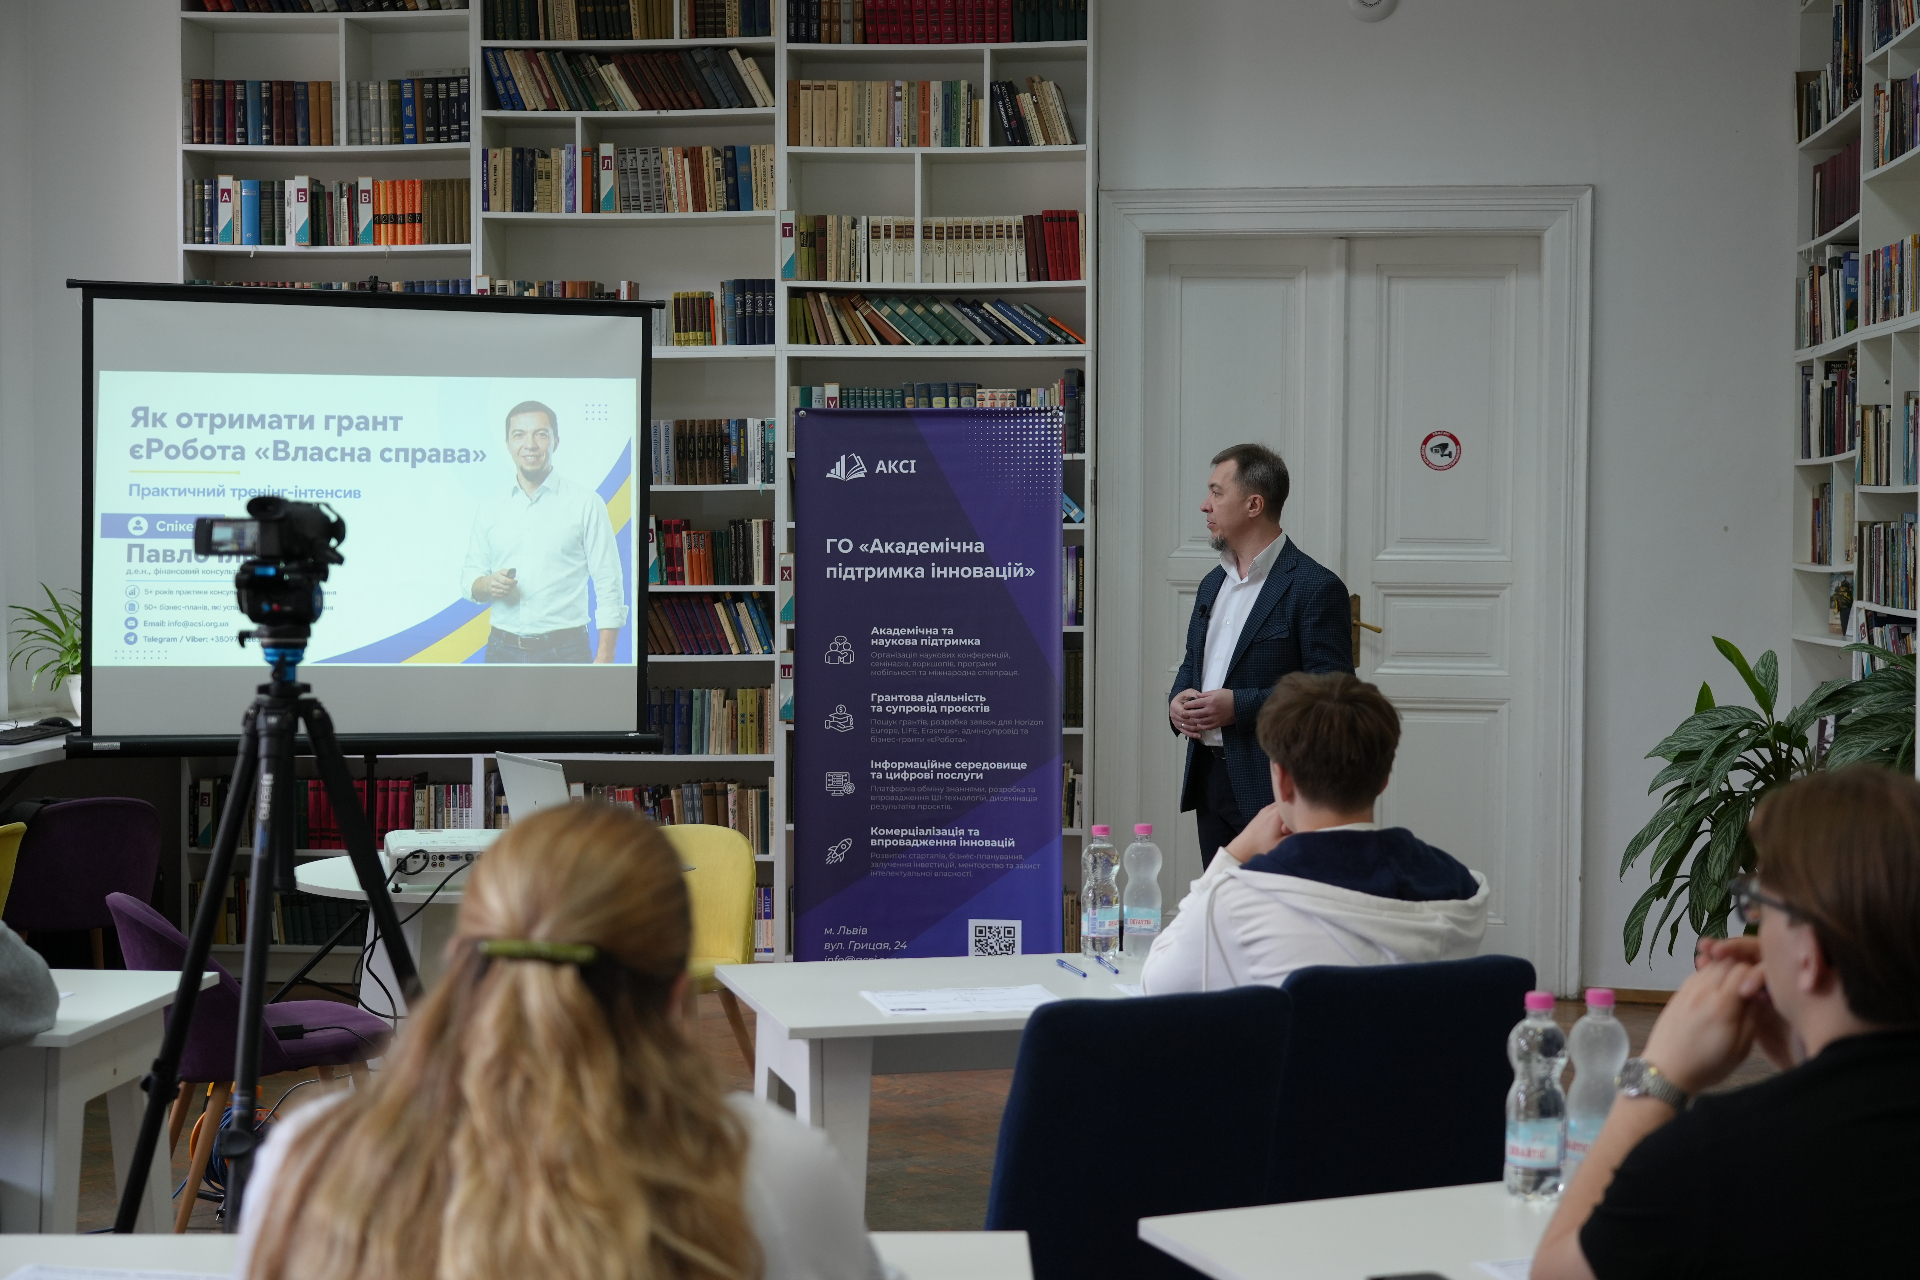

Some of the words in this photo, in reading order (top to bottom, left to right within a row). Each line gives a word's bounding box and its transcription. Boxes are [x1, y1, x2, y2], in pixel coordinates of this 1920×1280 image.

[222, 192, 230, 202] А
[297, 192, 305, 202] Б
[362, 193, 369, 203] В
[784, 226, 792, 236] Т
[130, 405, 167, 430] Як
[175, 410, 317, 434] отримати
[324, 413, 404, 436] грант
[129, 436, 246, 462] єРобота
[254, 439, 371, 464] «Власна
[379, 445, 487, 468] справа»
[128, 483, 226, 500] Практичний
[230, 485, 362, 500] тренінг-інтенсив
[156, 520, 196, 533] Спіке
[826, 538, 853, 554] ГО
[859, 537, 985, 556] «Академічна
[126, 543, 209, 564] Павло
[154, 567, 200, 576] фінансовий
[202, 568, 241, 576] консульта
[826, 563, 925, 582] підтримка
[931, 562, 1036, 580] інновацій»
[155, 588, 174, 597] років
[160, 603, 209, 612] бізнес-планів,
[223, 604, 240, 612] успі
[168, 620, 228, 629] info@acsi.org.ua
[871, 626, 938, 637] Академічна
[143, 635, 177, 644] Telegram
[871, 637, 918, 648] наукова
[921, 636, 980, 648] підтримка
[870, 650, 918, 660] Організація
[919, 652, 956, 660] наукових
[957, 660, 997, 670] програми
[871, 693, 924, 704] Грантова
[926, 692, 986, 704] діяльність
[871, 704, 883, 712] та
[886, 702, 937, 714] супровід
[940, 703, 990, 714] проєктів
[1014, 718, 1044, 726] Horizon
[871, 728, 900, 736] Europe,
[871, 760, 952, 772] Інформаційне
[954, 762, 1027, 772] середовище
[886, 769, 934, 782] цифрові
[937, 772, 983, 782] послуги
[871, 785, 915, 794] Платформа
[871, 826, 965, 838] Комерціалізація
[871, 838, 956, 848] впровадження
[960, 837, 1015, 849] інновацій
[958, 862, 1004, 870] менторство
[837, 926, 868, 936] Львів
[824, 942, 846, 952] вул.
[848, 941, 892, 952] Грицая,
[894, 941, 908, 950] 24
